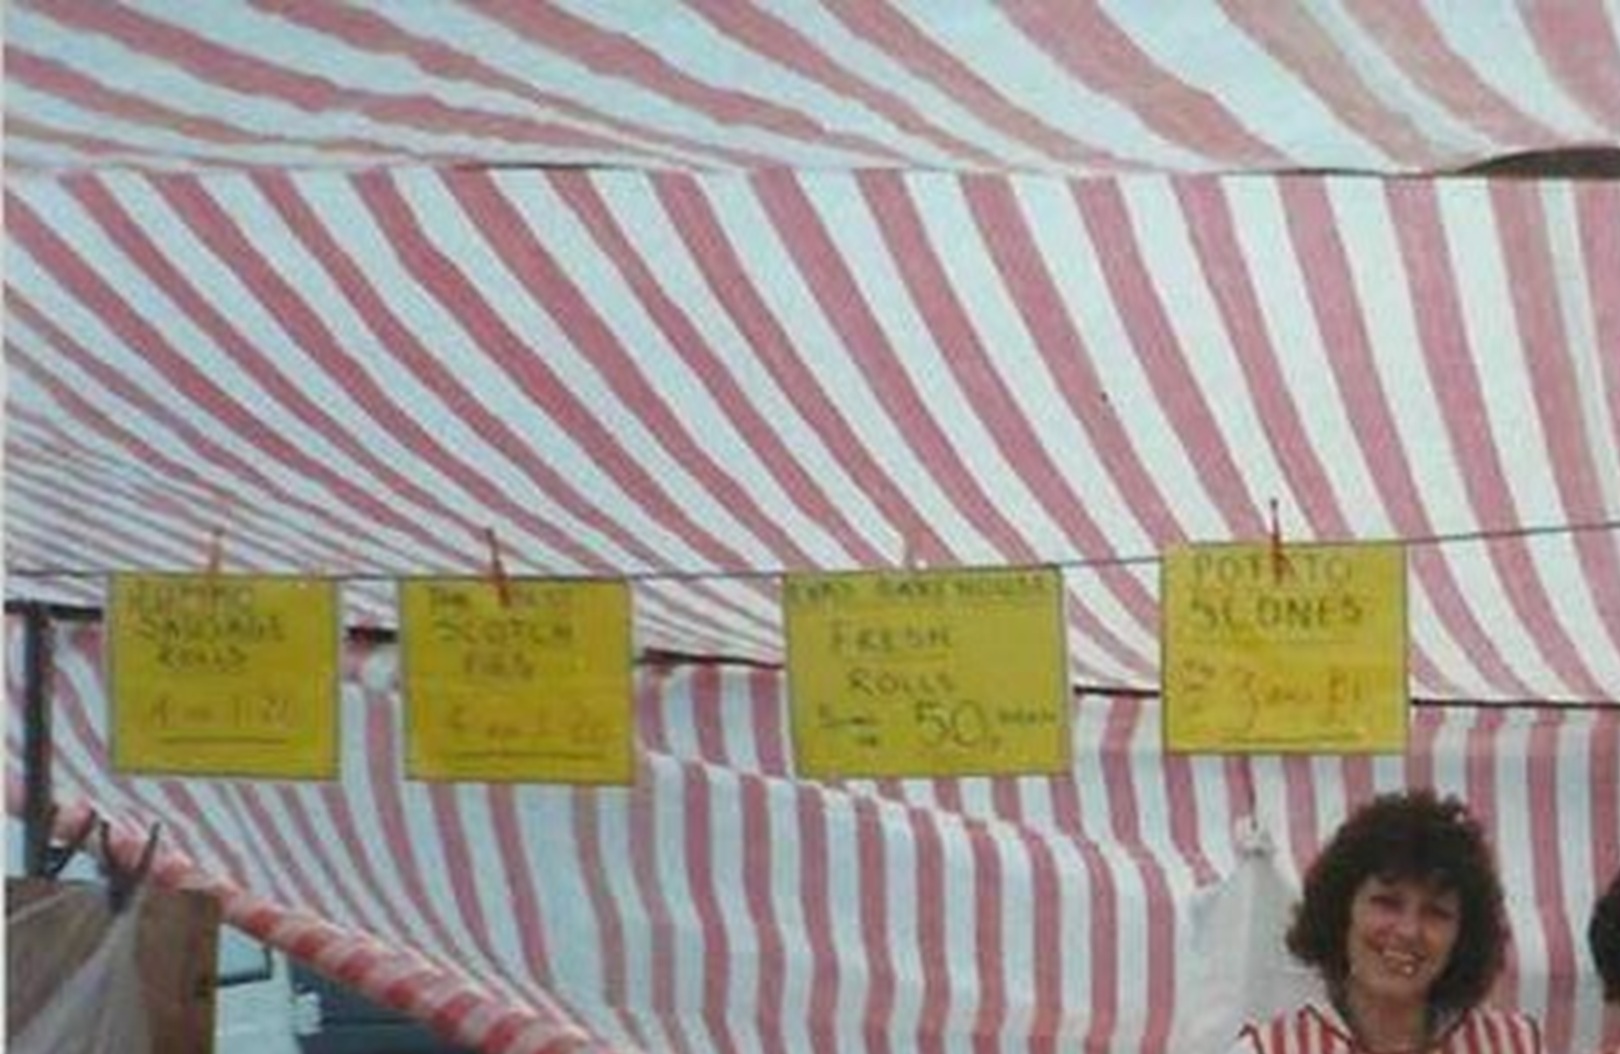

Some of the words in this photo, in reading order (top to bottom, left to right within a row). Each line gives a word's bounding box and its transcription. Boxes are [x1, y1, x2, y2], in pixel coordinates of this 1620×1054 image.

[1190, 594, 1363, 629] SCONES
[831, 619, 952, 653] FRESH
[846, 665, 956, 696] ROLLS
